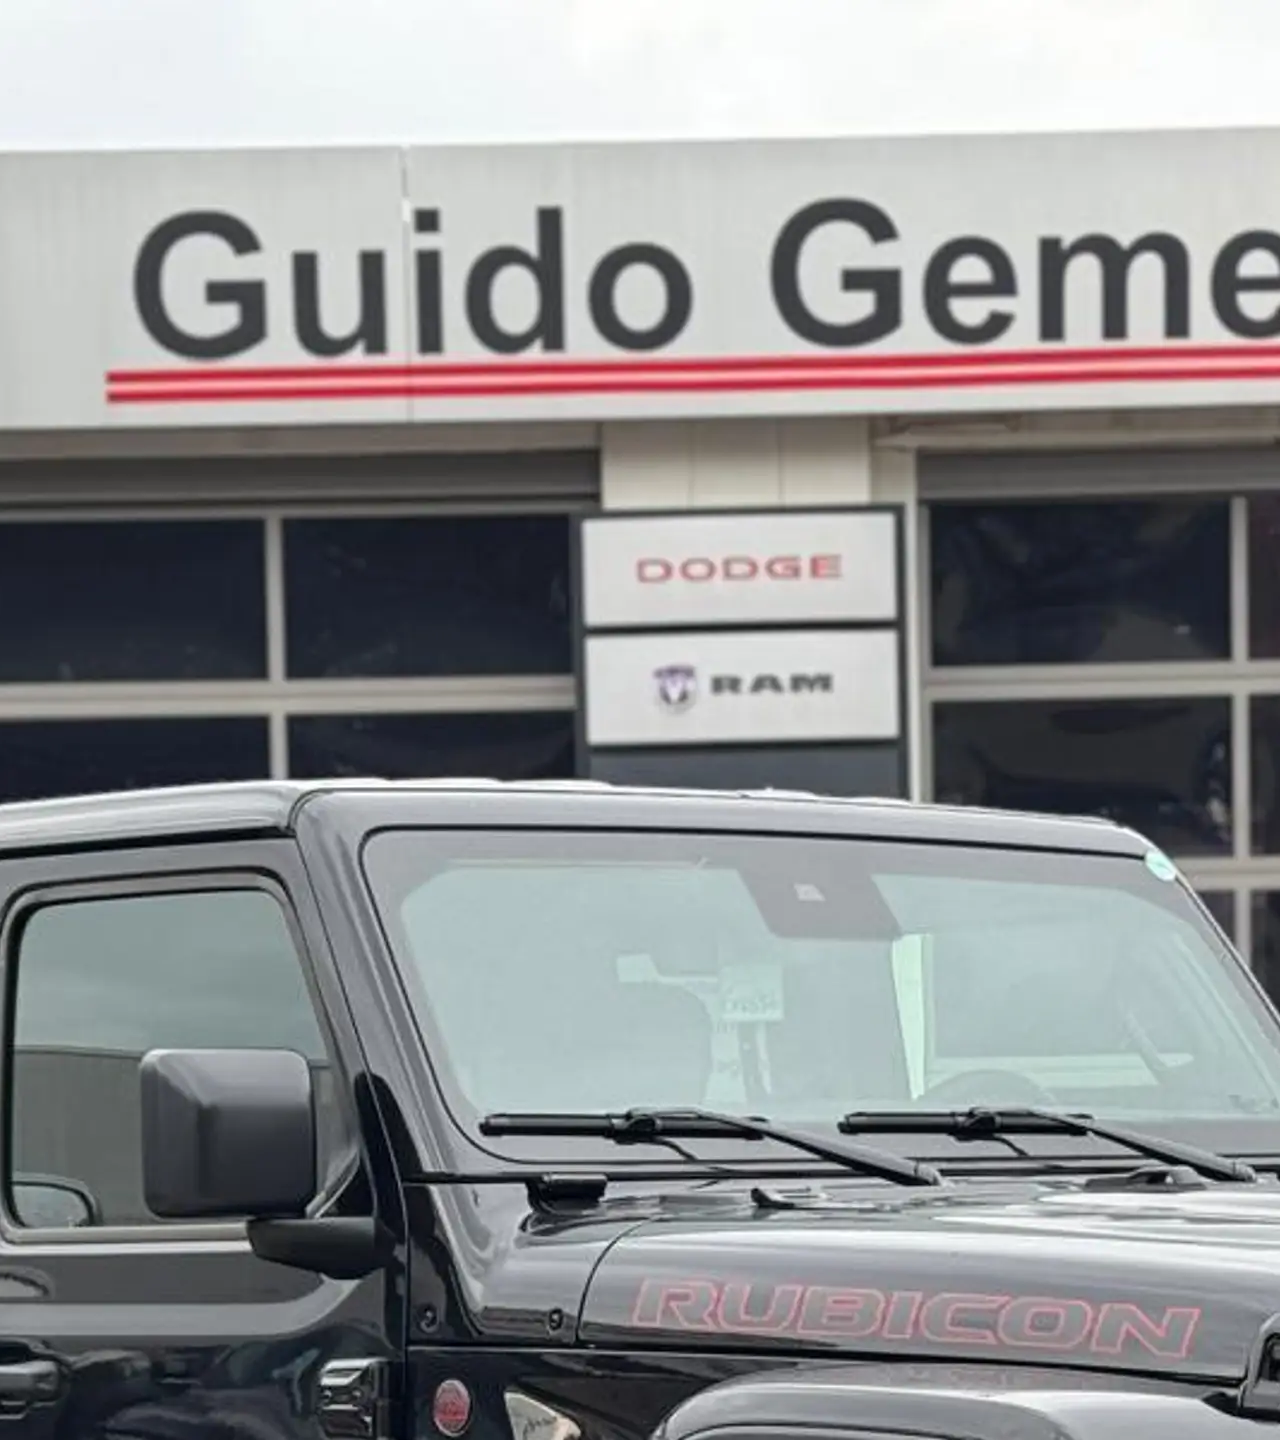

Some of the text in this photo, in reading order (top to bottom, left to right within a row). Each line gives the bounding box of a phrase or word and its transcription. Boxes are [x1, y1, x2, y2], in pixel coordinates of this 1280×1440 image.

[133, 206, 693, 362] Guido
[636, 553, 843, 583] DODGE
[709, 672, 835, 696] RAM
[632, 1277, 1200, 1358] RUBICON
